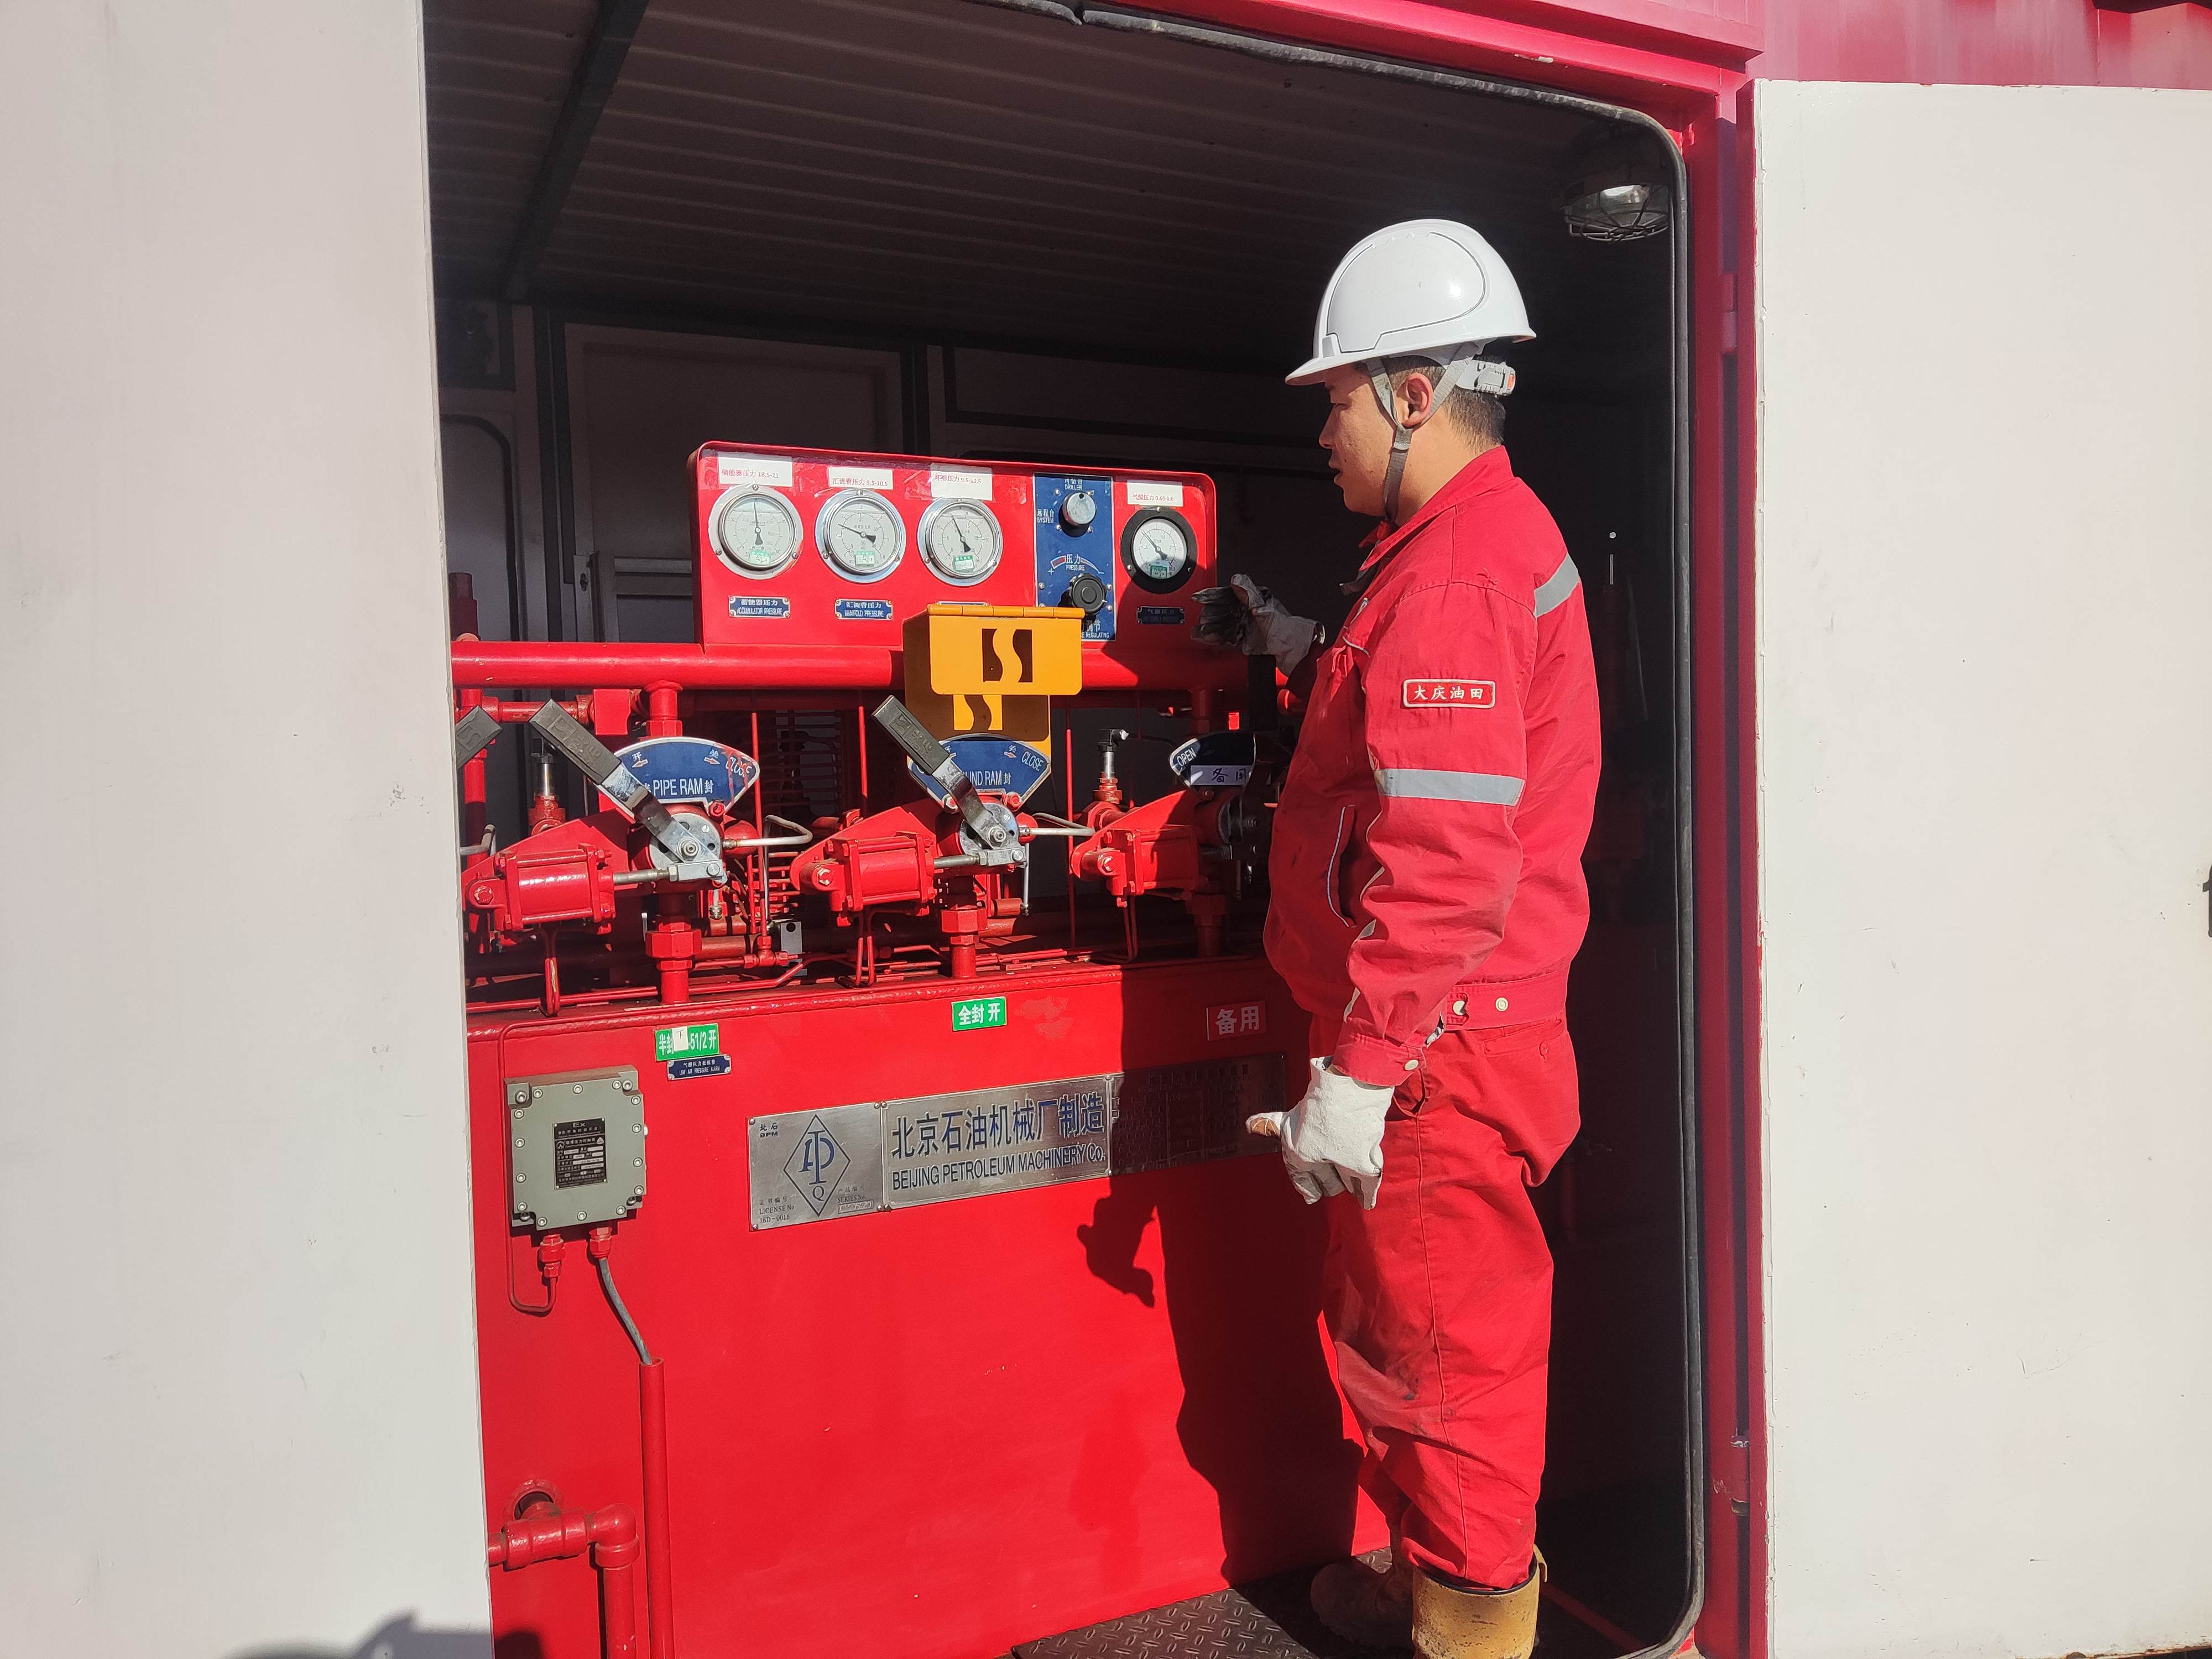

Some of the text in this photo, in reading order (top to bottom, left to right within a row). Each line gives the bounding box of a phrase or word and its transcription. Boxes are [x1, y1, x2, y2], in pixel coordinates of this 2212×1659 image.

[1066, 553, 1081, 564] 压力
[1413, 685, 1484, 701] 大庆油田
[632, 751, 642, 761] 开
[1021, 750, 1044, 771] CLOSE
[1177, 747, 1197, 766] OPEN
[985, 770, 1001, 785] RAM
[653, 779, 677, 796] PIPE
[680, 778, 703, 795] RAM
[1215, 1006, 1259, 1035] 备用
[891, 1092, 1105, 1159] 北京石油机械厂制造
[892, 1166, 940, 1191] BEIJING
[942, 1154, 1015, 1183] PETROLEUM
[1018, 1143, 1086, 1173] MACHINERY
[812, 1186, 825, 1201] Q
[837, 1194, 857, 1203] SERIES
[759, 1205, 786, 1215] LICENSE
